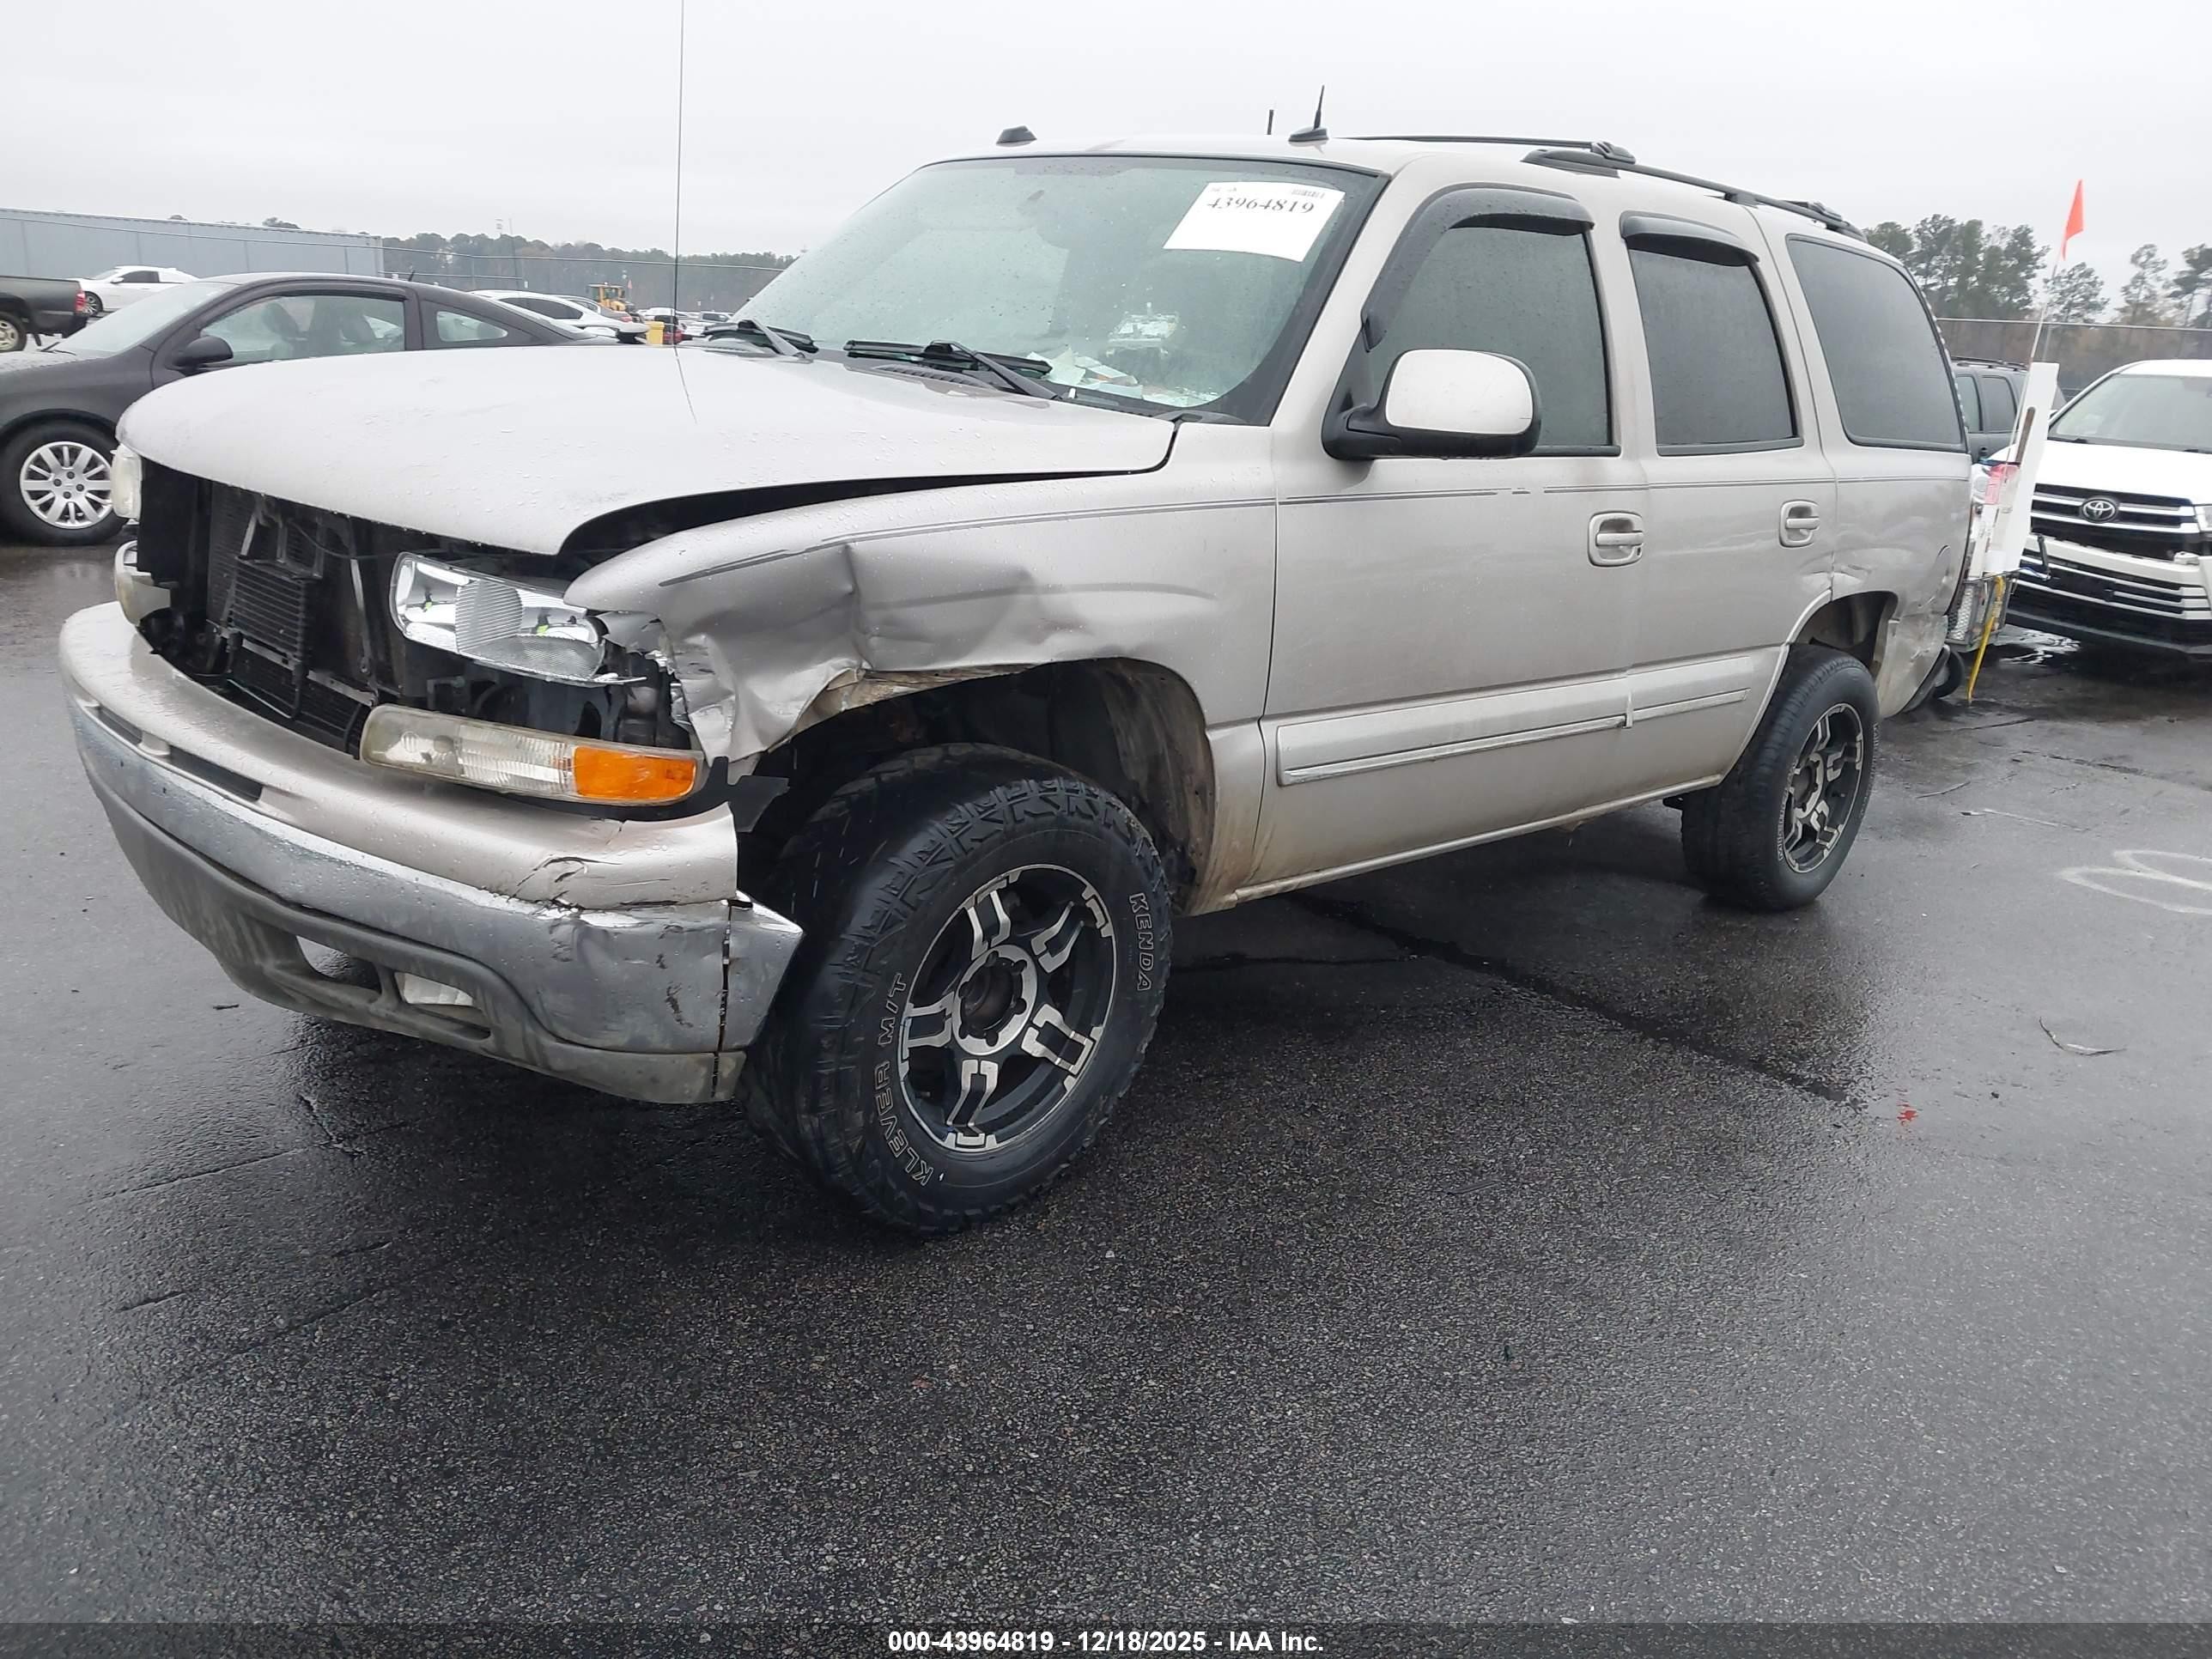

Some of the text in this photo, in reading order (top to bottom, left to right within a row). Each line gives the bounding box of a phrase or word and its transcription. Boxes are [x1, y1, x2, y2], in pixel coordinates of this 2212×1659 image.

[1207, 197, 1315, 214] 43964819
[1128, 892, 1154, 991] KENDA
[874, 973, 934, 1187] KLEVER M/T
